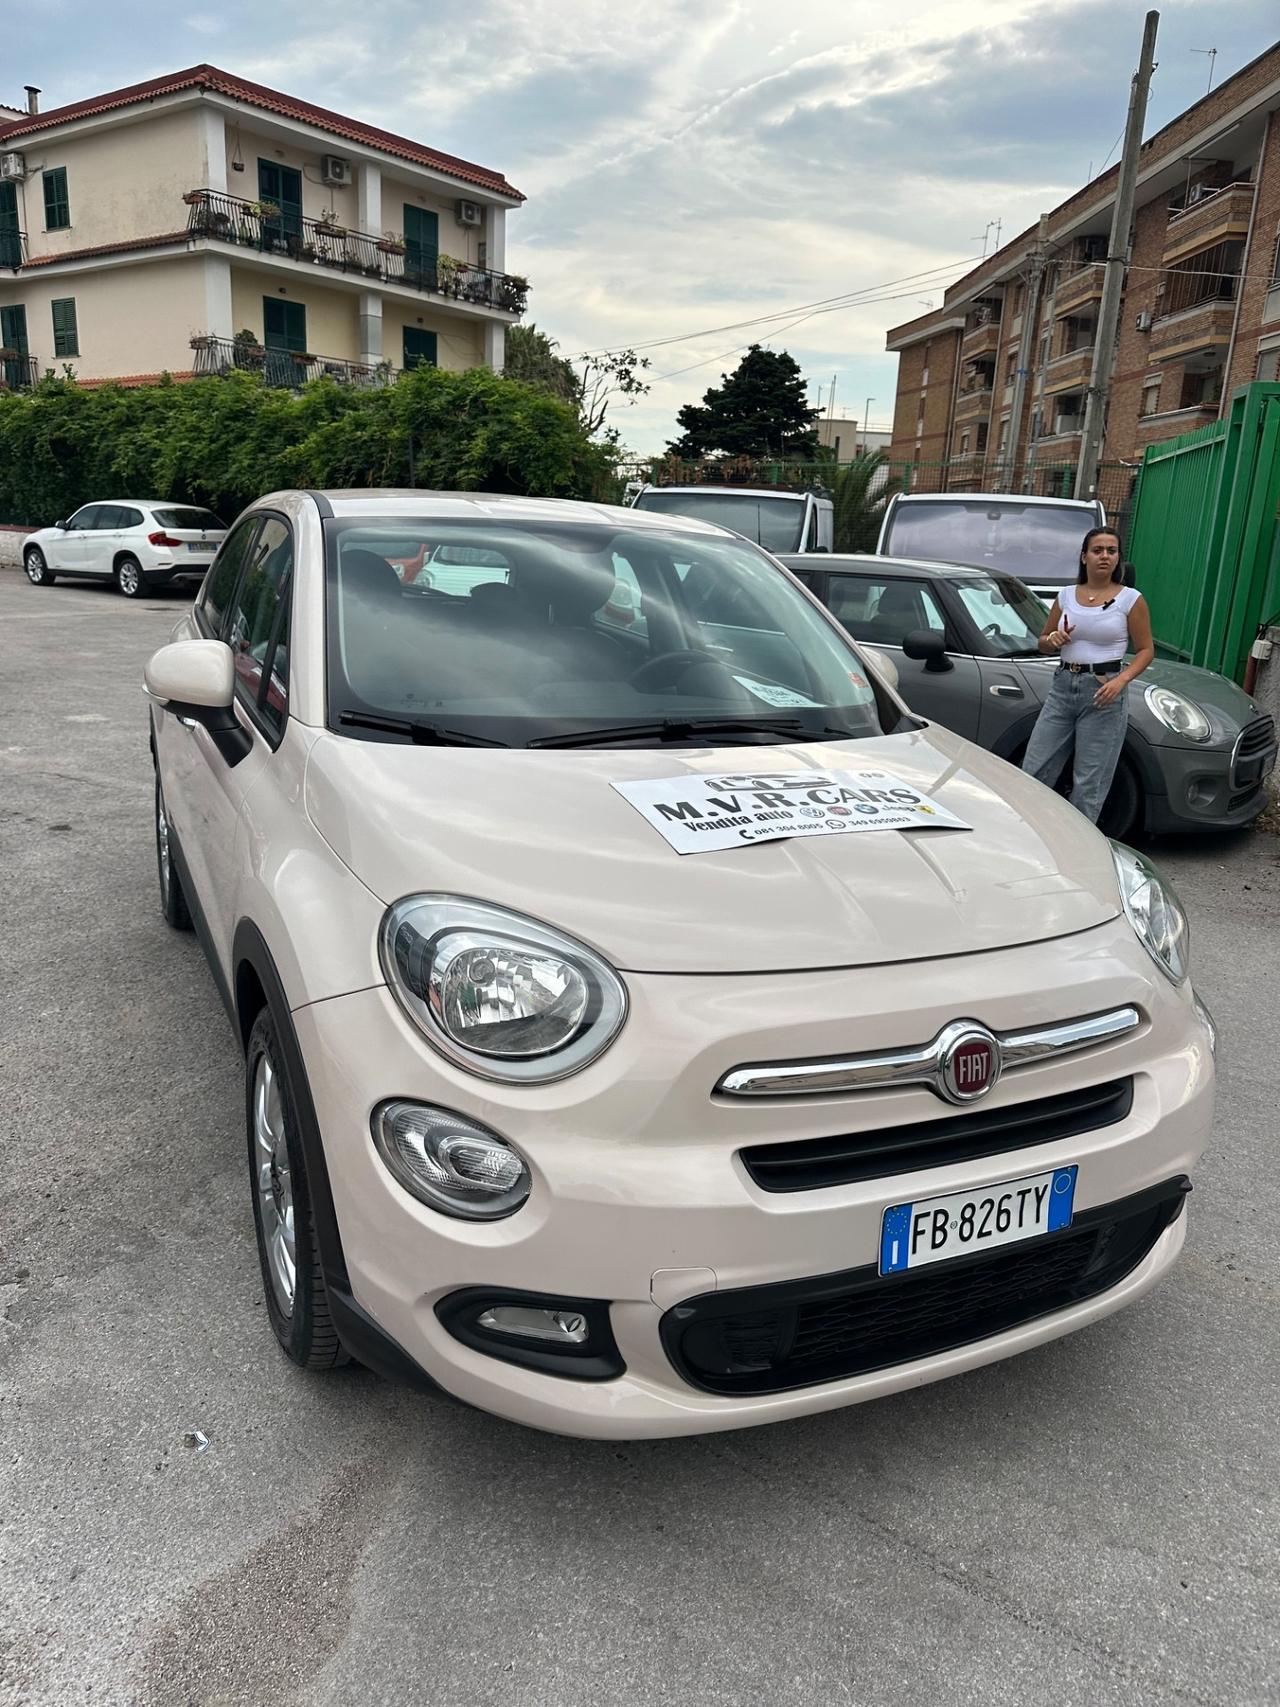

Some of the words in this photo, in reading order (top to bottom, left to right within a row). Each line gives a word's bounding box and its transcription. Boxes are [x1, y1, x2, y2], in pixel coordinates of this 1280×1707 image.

[684, 813, 753, 832] Vendita
[754, 809, 794, 821] auto
[960, 1052, 988, 1083] FIAT
